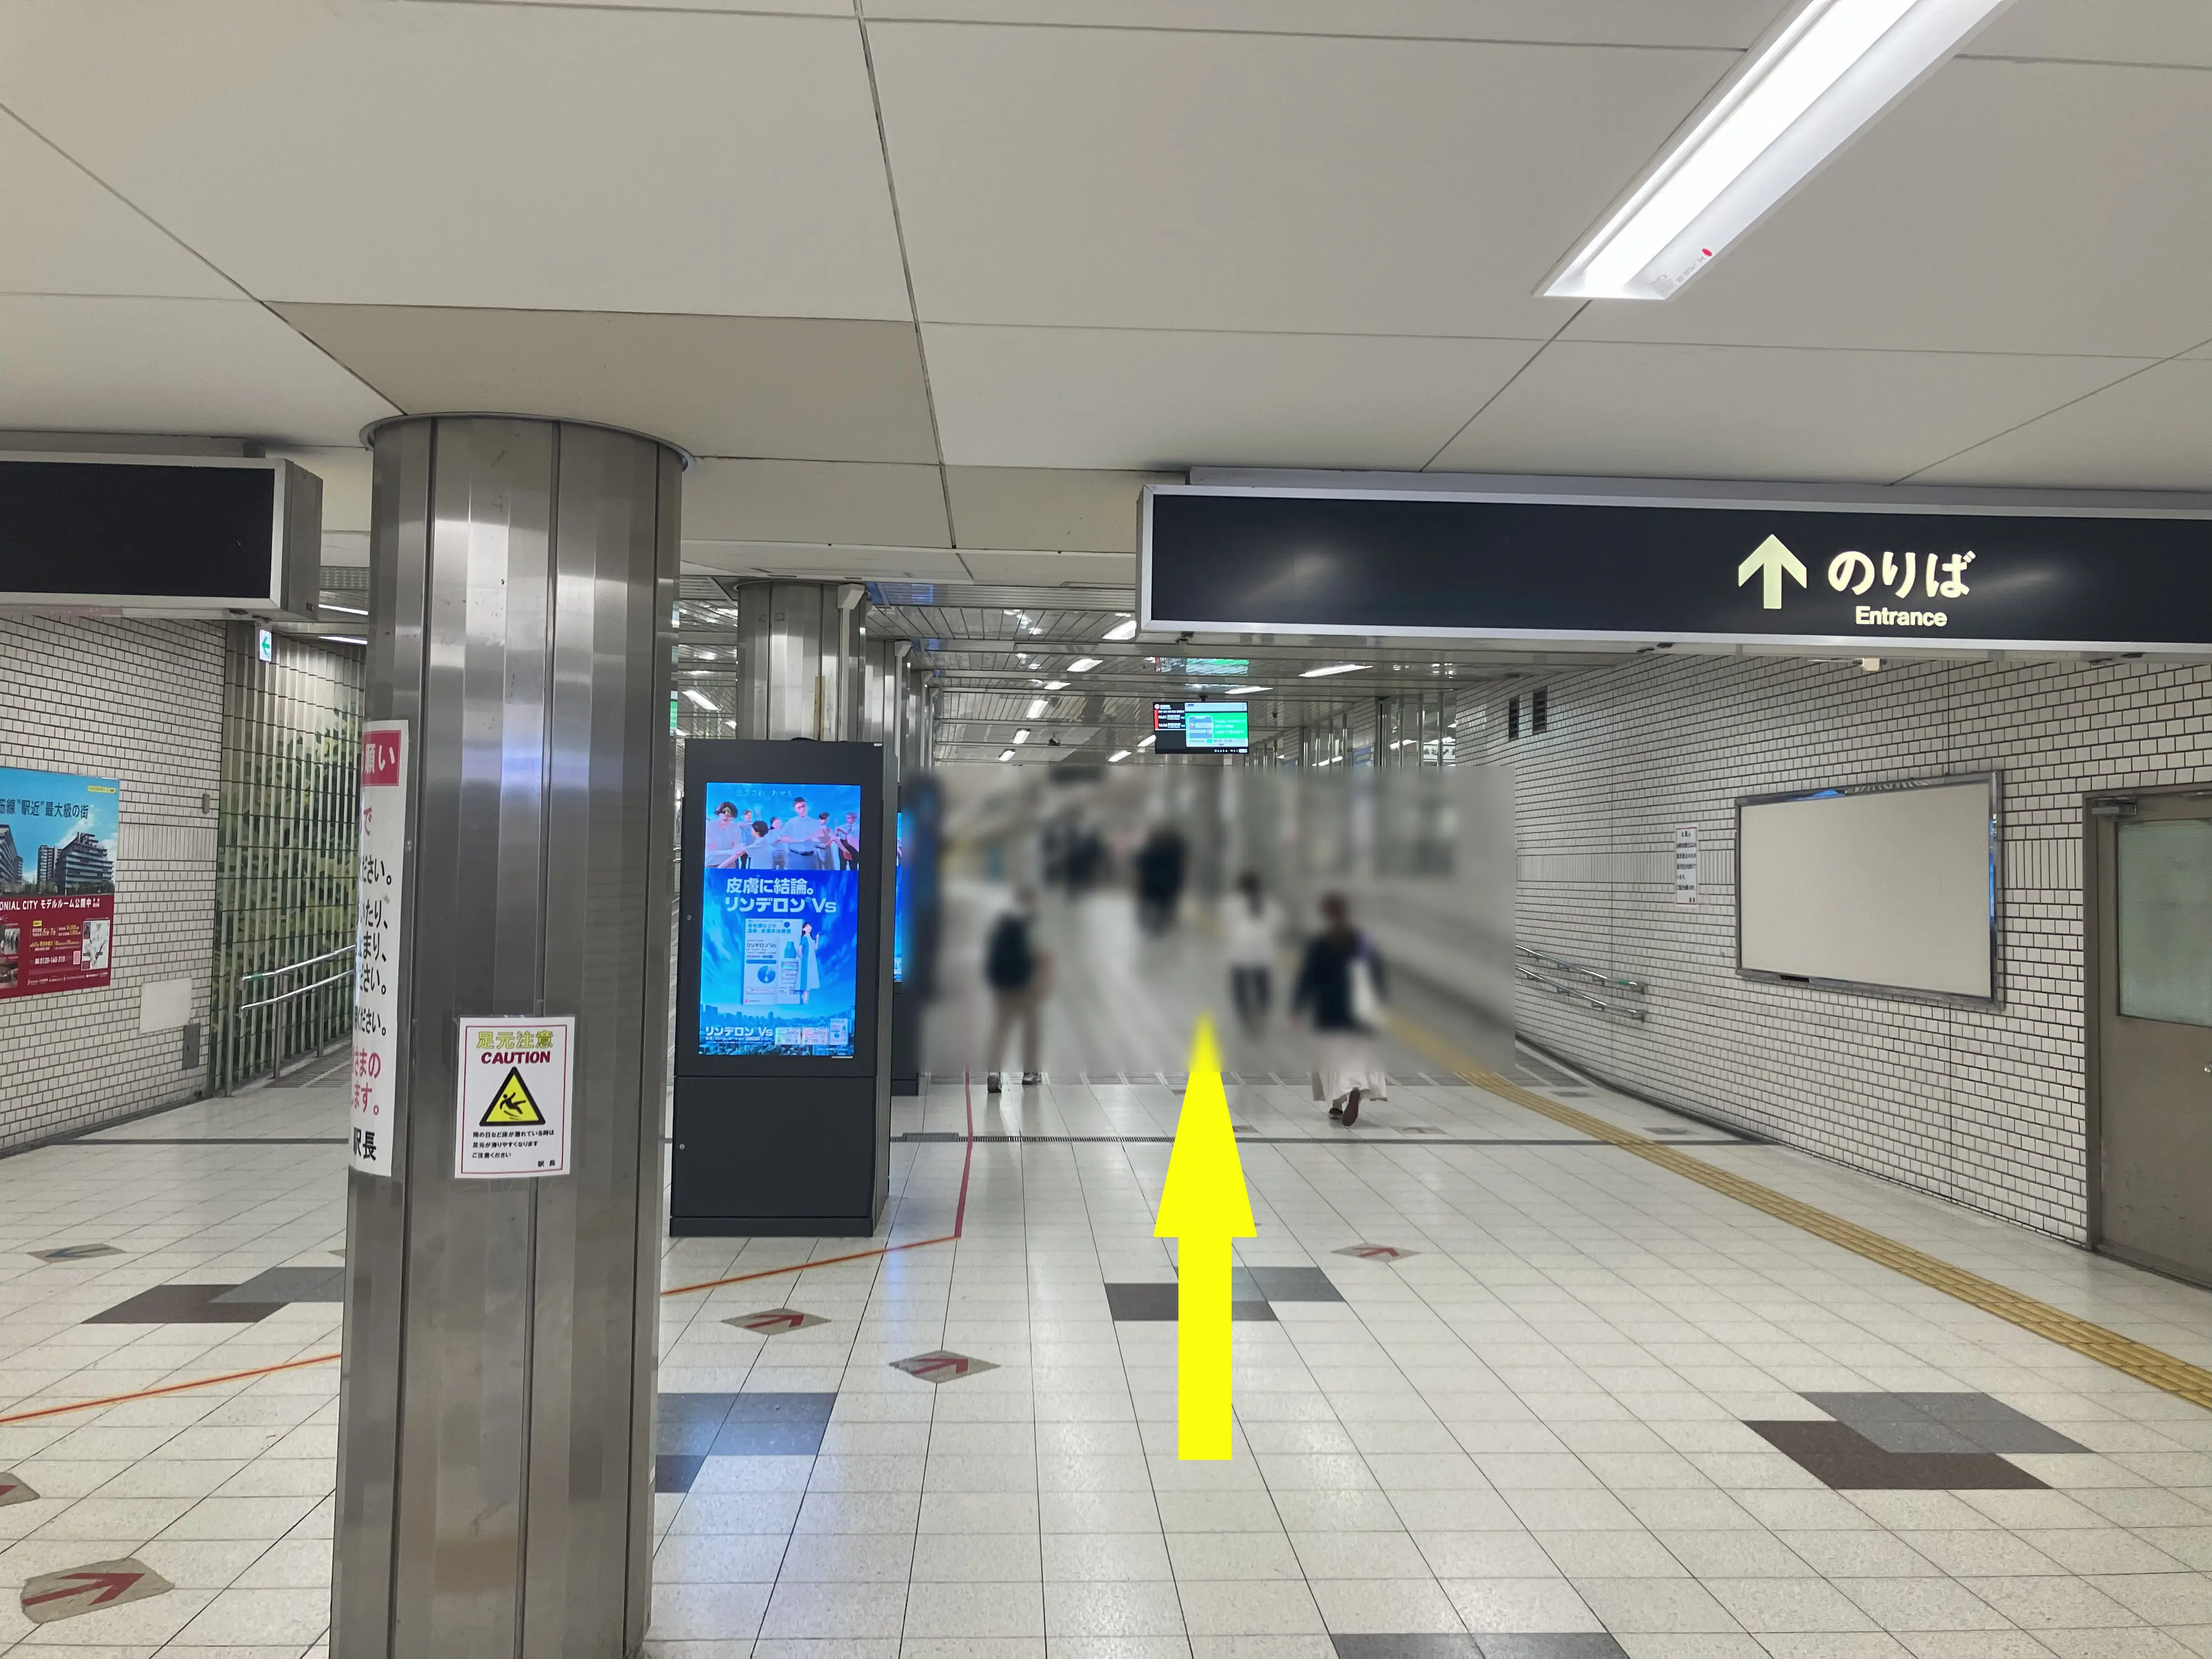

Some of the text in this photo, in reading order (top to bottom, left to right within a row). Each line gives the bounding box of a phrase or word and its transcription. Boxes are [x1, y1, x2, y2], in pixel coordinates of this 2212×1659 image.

[1827, 550, 1976, 599] のりば
[1855, 606, 1948, 627] Entrance
[361, 743, 396, 774] 願い
[726, 878, 814, 895] 皮膚に結論。
[22, 900, 38, 910] CITY
[476, 1030, 554, 1049] 足元注意
[758, 1026, 774, 1036] Vs
[353, 1045, 381, 1079] さまの
[481, 1051, 550, 1064] CAUTION
[352, 1080, 379, 1115] ます。
